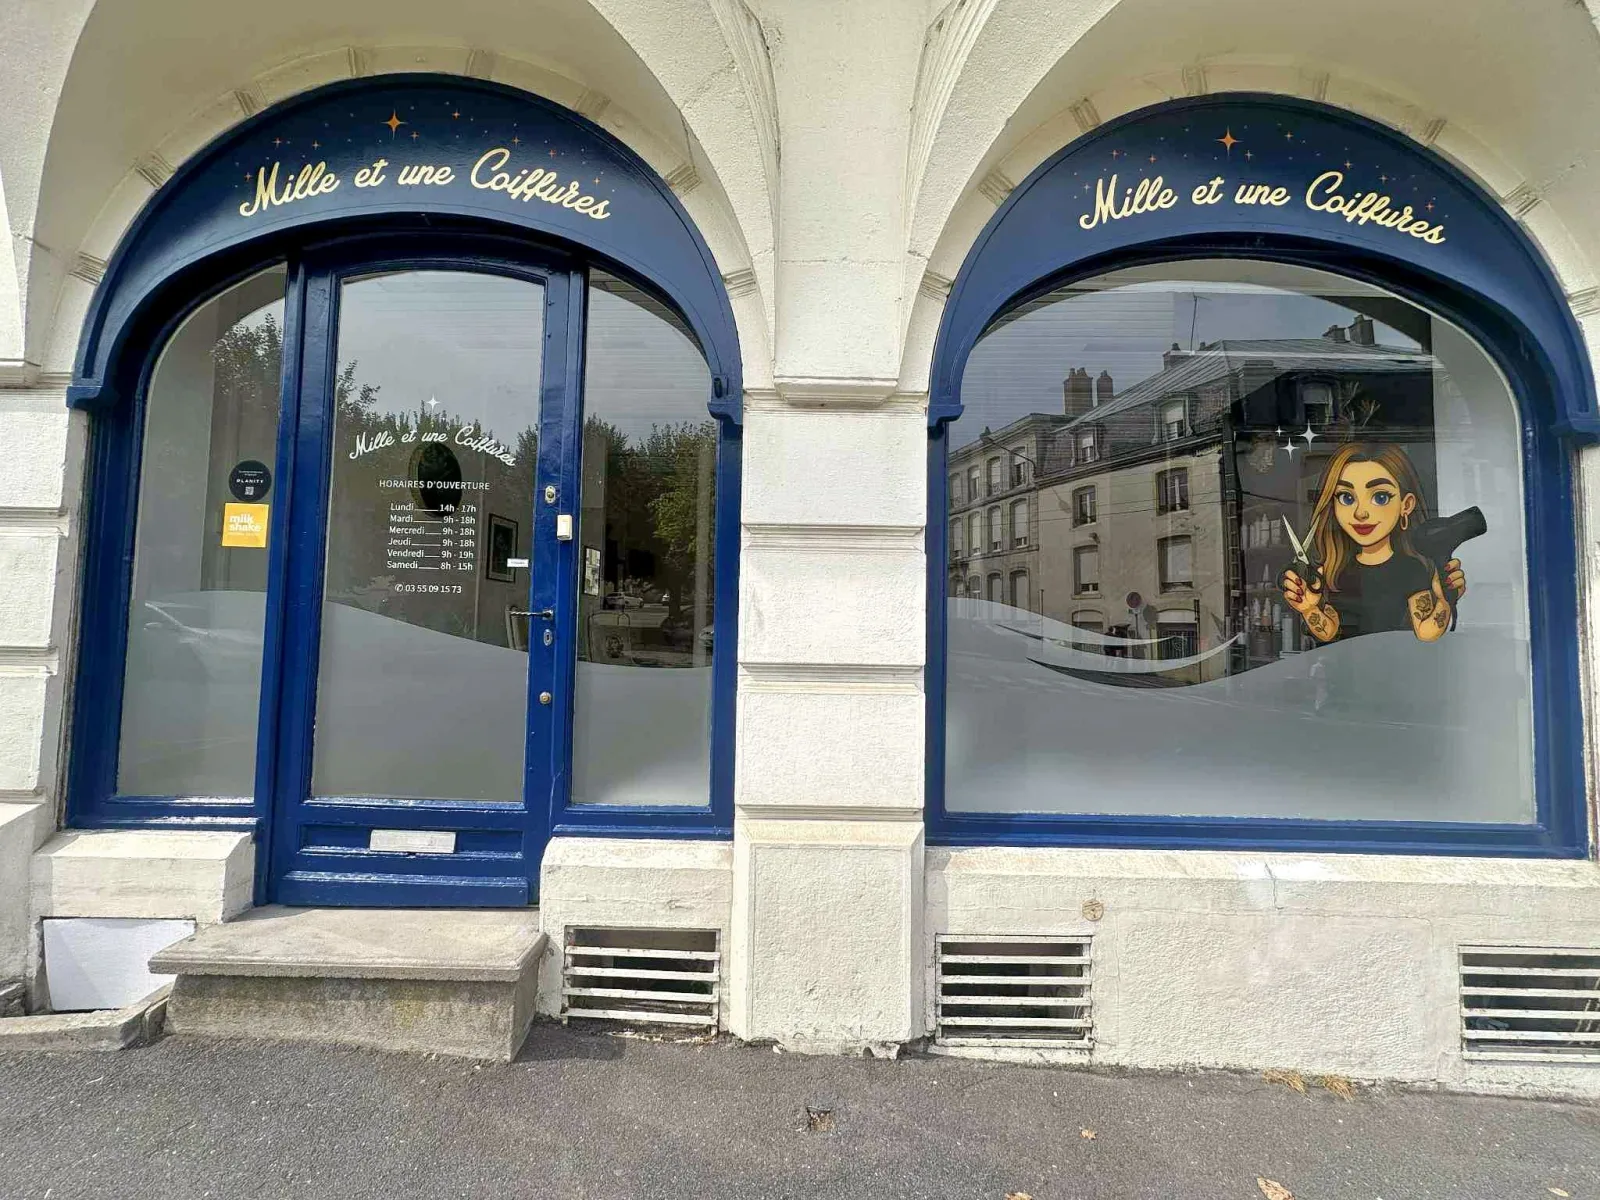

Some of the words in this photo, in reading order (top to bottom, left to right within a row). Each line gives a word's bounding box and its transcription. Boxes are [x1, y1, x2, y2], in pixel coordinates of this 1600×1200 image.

[239, 161, 339, 217] Mille
[354, 158, 389, 188] et
[398, 163, 455, 185] une
[470, 147, 611, 220] Coiffures
[1079, 174, 1178, 230] Mille
[1192, 176, 1224, 205] et
[1234, 183, 1291, 206] une
[1305, 171, 1447, 245] Coiffures
[349, 430, 395, 459] Mille
[401, 430, 417, 443] et
[422, 432, 448, 442] une
[455, 425, 516, 466] Coiffures
[379, 480, 424, 488] HORAIRES
[427, 481, 490, 490] D'OUVERTURE
[440, 504, 454, 512] 14h
[229, 513, 254, 523] milk
[461, 516, 475, 524] 18h
[389, 526, 425, 534] Mercredi
[460, 539, 474, 547] 18h
[387, 549, 424, 557] Vendredi
